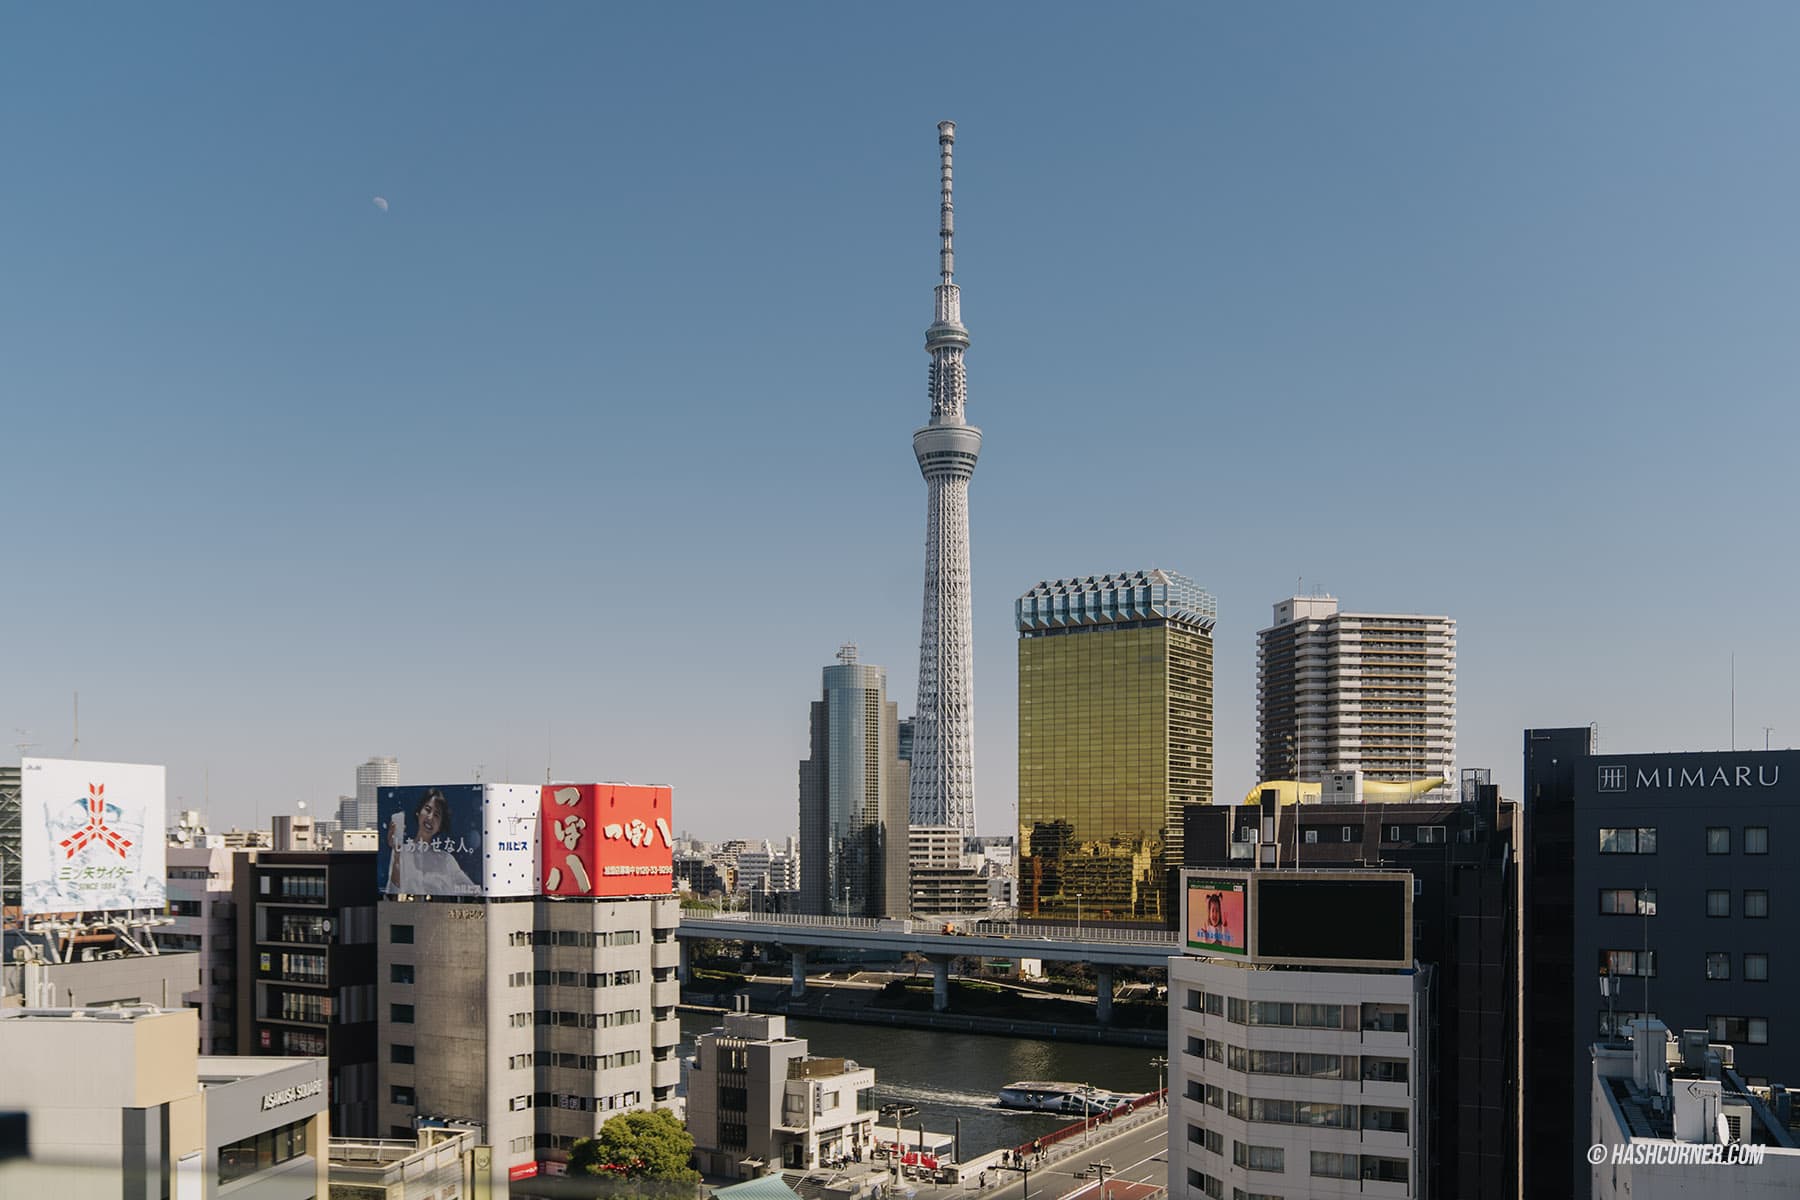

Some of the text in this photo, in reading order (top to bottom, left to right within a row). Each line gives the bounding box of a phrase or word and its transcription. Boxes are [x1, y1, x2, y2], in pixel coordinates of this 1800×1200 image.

[1636, 765, 1779, 788] MIMARU
[546, 787, 592, 893] つぼ八
[604, 818, 672, 848] つぼ八
[393, 836, 475, 855] しあわせな人。
[498, 841, 528, 851] カルピス
[59, 866, 134, 880] 三ツ矢サイダー
[263, 1079, 323, 1111] ASAKUSA SQUARE
